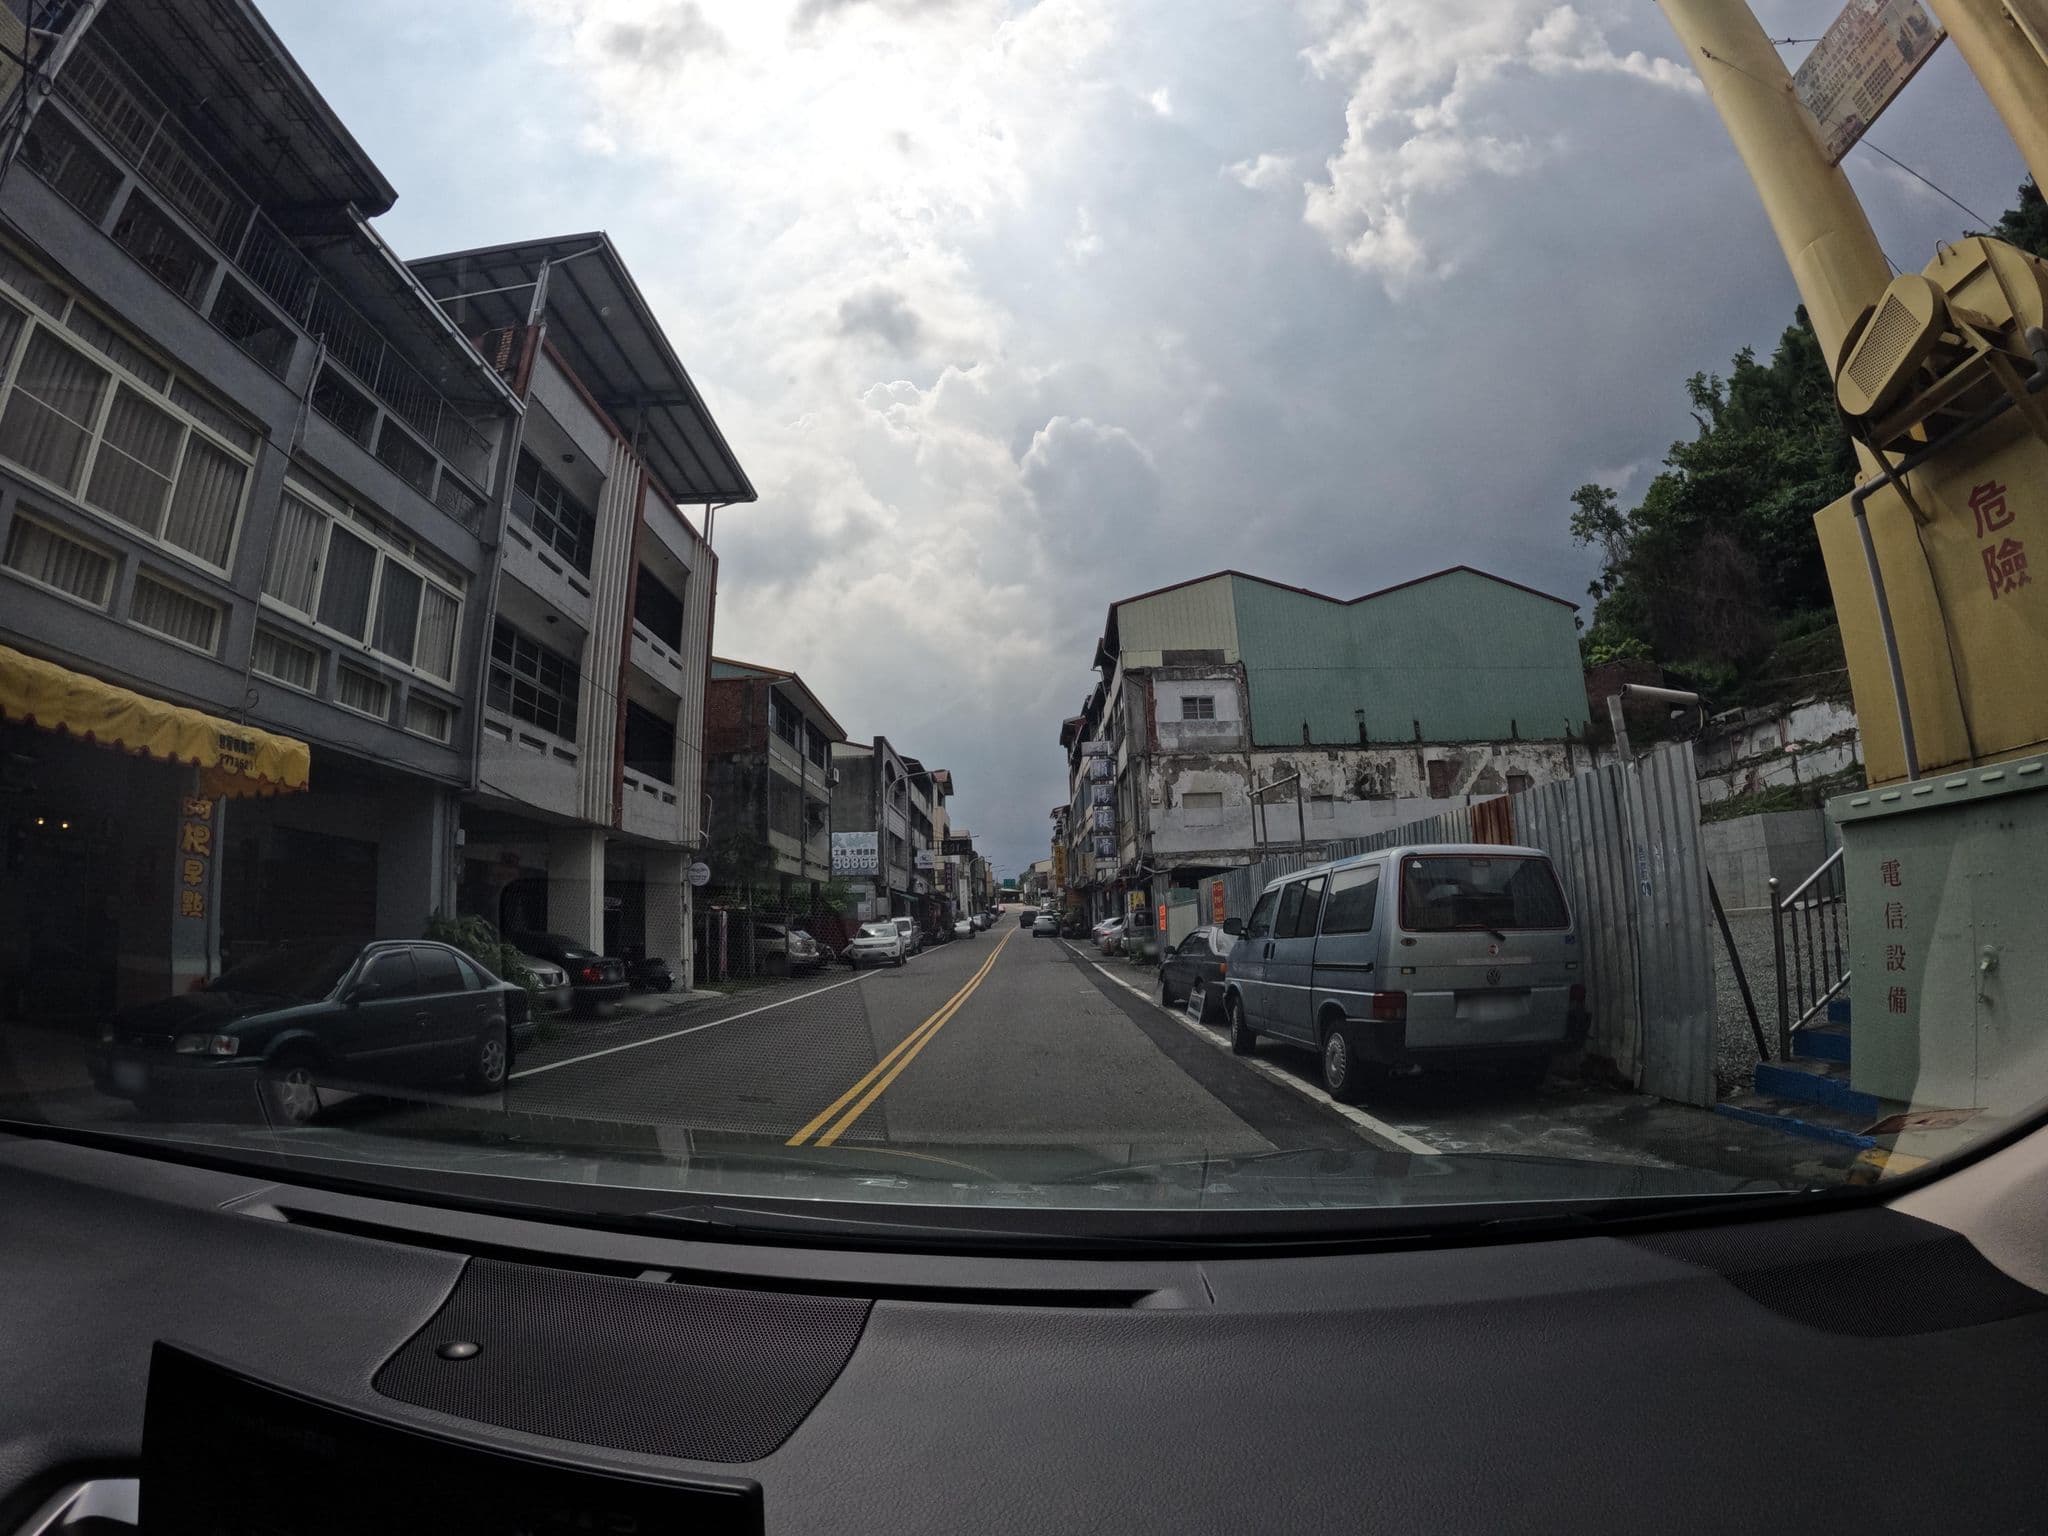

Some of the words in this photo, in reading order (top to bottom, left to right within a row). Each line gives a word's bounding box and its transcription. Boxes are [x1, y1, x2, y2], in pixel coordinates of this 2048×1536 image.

[1968, 480, 2032, 600] 危險
[1880, 858, 1908, 1014] 電信設備
